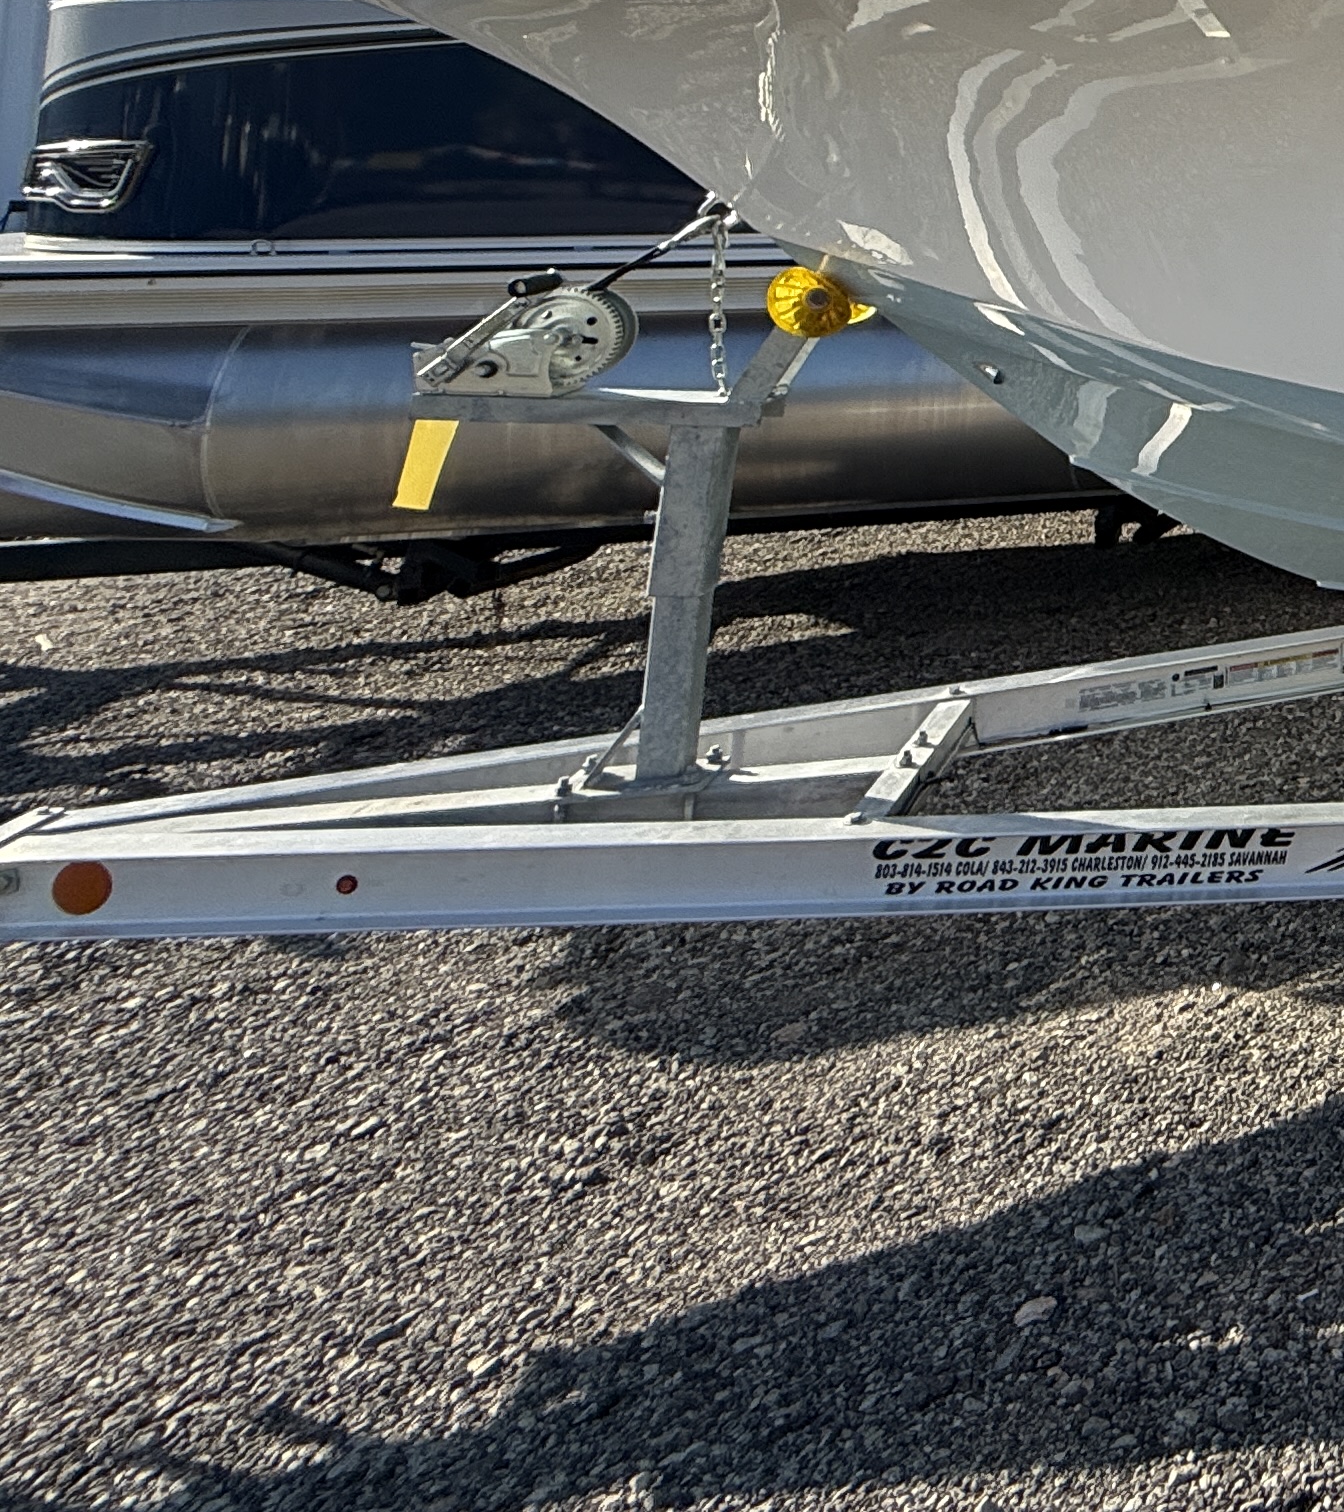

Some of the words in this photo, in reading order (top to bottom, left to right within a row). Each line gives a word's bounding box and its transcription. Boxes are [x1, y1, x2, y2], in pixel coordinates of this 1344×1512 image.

[872, 836, 998, 860] C2C
[1016, 826, 1296, 856] MARINE
[874, 862, 953, 879] 803-814-1514
[991, 857, 1068, 875] 843-212-3915
[1071, 853, 1148, 872] CHARLESTON/
[1150, 851, 1226, 870] 912-445-2185
[1228, 850, 1288, 867] SAVANNAH
[885, 880, 926, 896] BY
[934, 878, 1020, 894] ROAD
[1029, 874, 1109, 891] KING
[1120, 869, 1264, 888] TRAILERS
